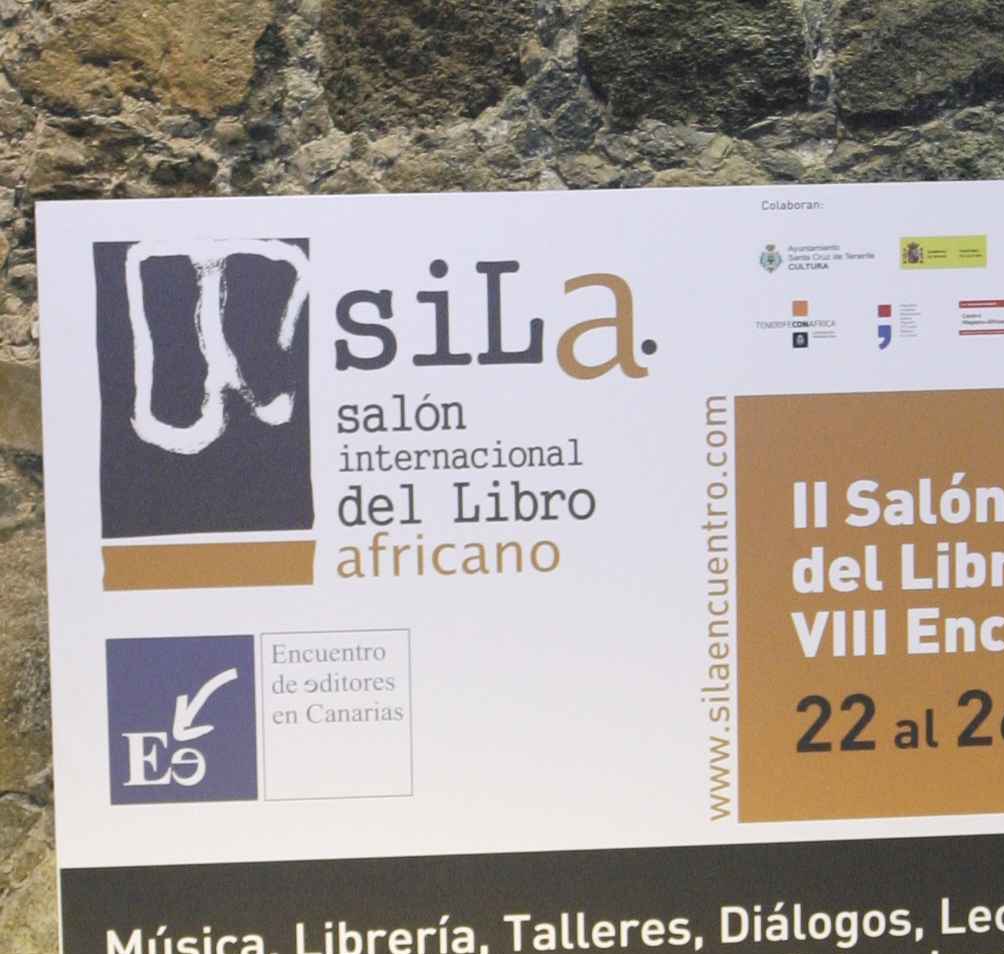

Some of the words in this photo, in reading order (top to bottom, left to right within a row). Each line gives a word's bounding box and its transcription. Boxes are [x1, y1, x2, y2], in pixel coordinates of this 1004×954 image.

[761, 200, 825, 211] Colaboran:
[787, 245, 840, 253] Ayuntamiento
[788, 263, 829, 271] CULTURA
[845, 252, 875, 260] Tenerife
[336, 393, 467, 434] salón
[338, 438, 584, 473] internacional
[338, 484, 423, 527] del
[452, 480, 597, 523] Libro
[792, 481, 828, 529] II
[336, 531, 561, 580] africano
[792, 545, 883, 594] del
[701, 394, 732, 822] www.silaencuentro.com
[271, 642, 387, 665] Encuentro
[790, 608, 887, 659] VIII
[271, 673, 298, 695] de
[272, 708, 298, 725] en
[306, 701, 404, 724] Canarias
[796, 693, 876, 754] 22
[894, 708, 939, 749] al
[503, 911, 704, 952] Talleres,
[721, 902, 924, 950] Diálogos,
